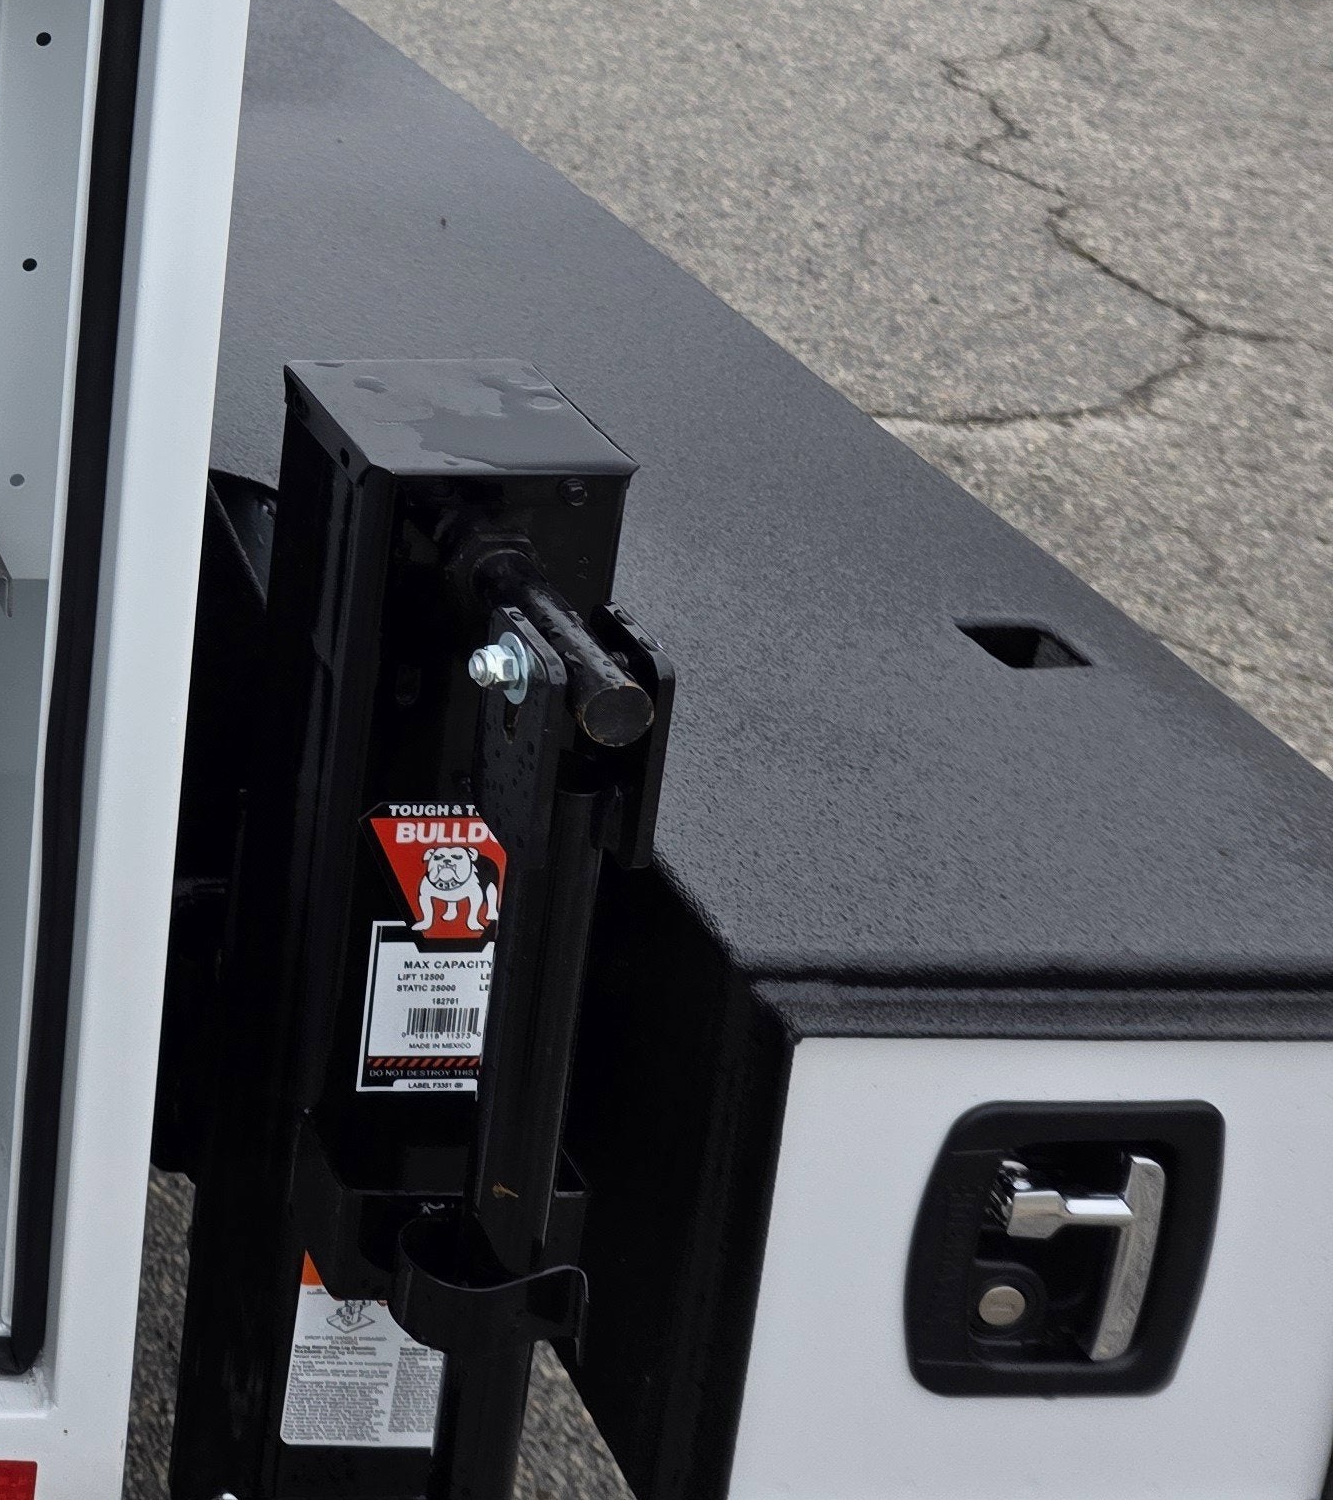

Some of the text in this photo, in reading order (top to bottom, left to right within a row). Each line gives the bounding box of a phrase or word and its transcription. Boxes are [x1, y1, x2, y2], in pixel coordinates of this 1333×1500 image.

[388, 804, 450, 817] TOUGH
[451, 804, 463, 816] &
[404, 960, 493, 969] MAX CAPACITY
[397, 973, 418, 981] LIFT
[419, 973, 445, 981] 12500
[396, 984, 428, 992] STATIC
[430, 984, 457, 992] 25000
[441, 1042, 472, 1050] MEXICO
[369, 1069, 383, 1077] DO
[385, 1069, 404, 1077] NOT
[406, 1069, 451, 1077] DESTROY
[453, 1069, 474, 1077] THIS
